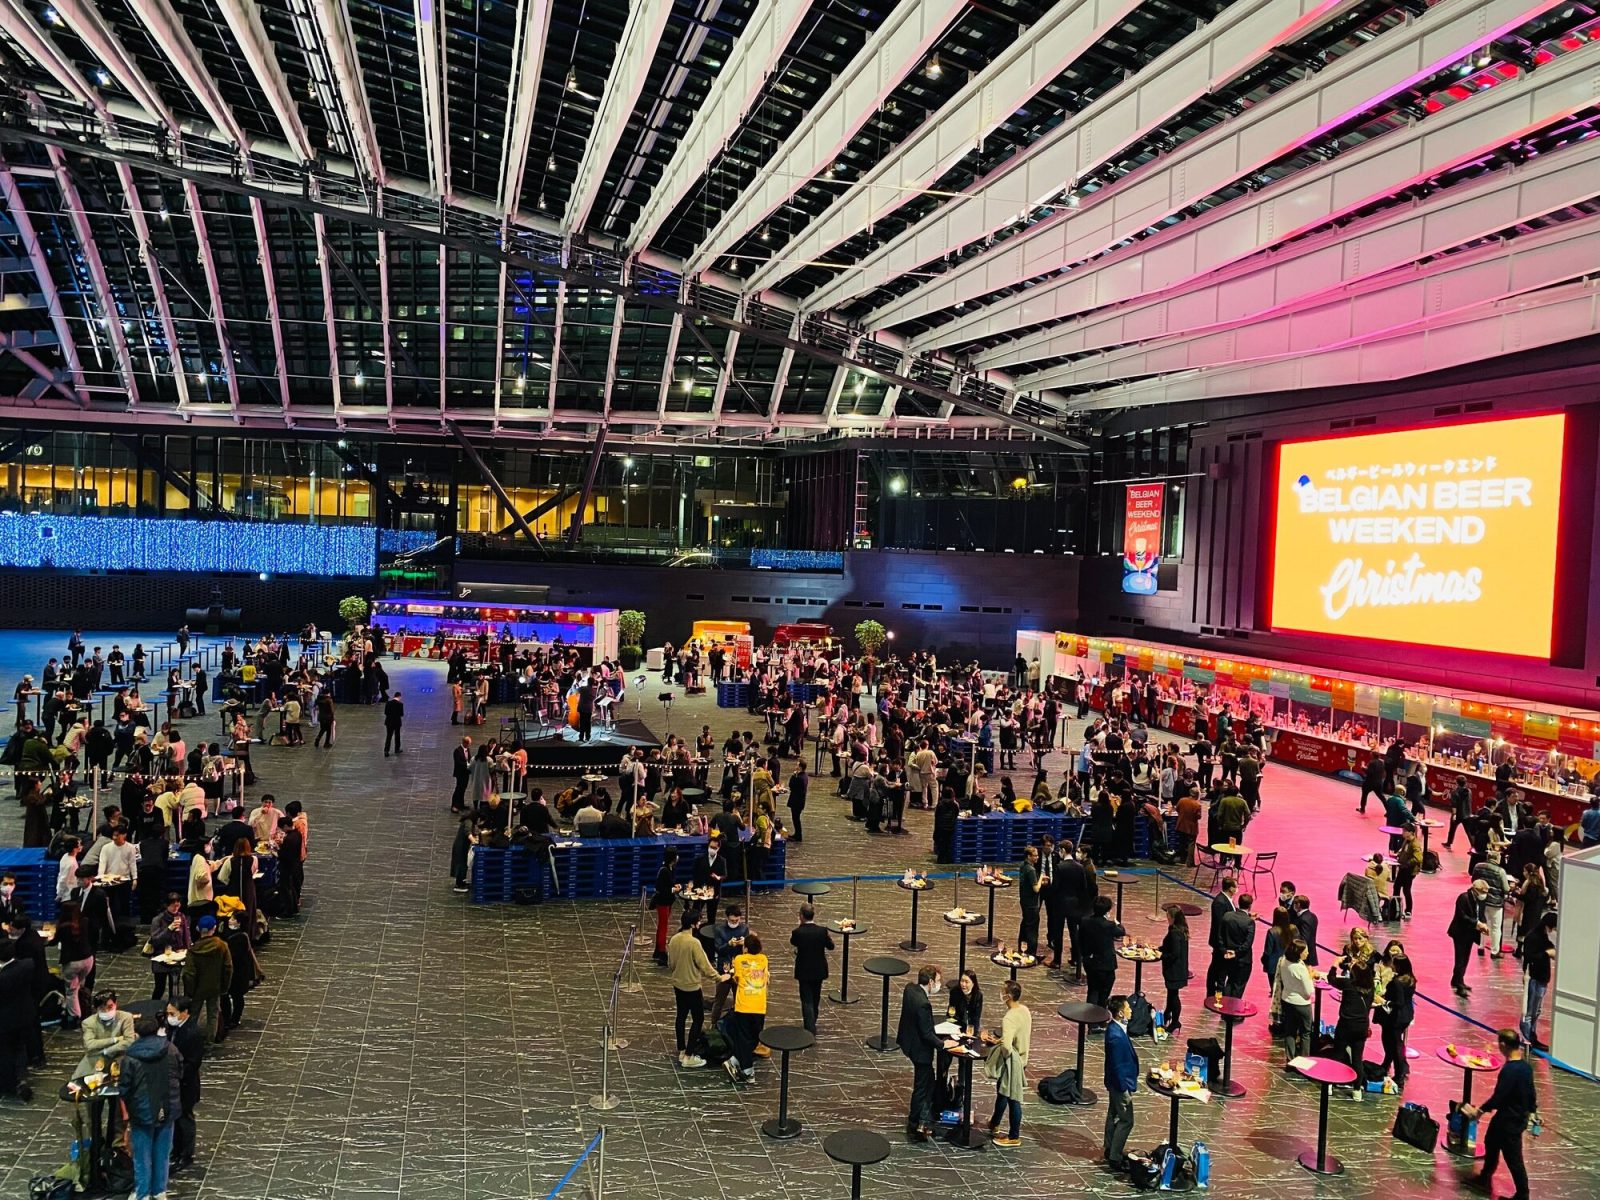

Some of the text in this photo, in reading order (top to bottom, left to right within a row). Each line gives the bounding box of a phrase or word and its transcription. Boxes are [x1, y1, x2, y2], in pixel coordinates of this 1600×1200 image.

[1326, 456, 1497, 480] ベルギービールウィークエンド
[1130, 490, 1159, 498] BELGIAN
[1299, 477, 1532, 513] BELGIAN BEER
[1135, 500, 1153, 508] BEER
[1127, 510, 1160, 518] WEEKEND
[1128, 521, 1157, 536] Christmas
[1328, 516, 1486, 545] WEEKEND
[1321, 552, 1482, 620] Christmas
